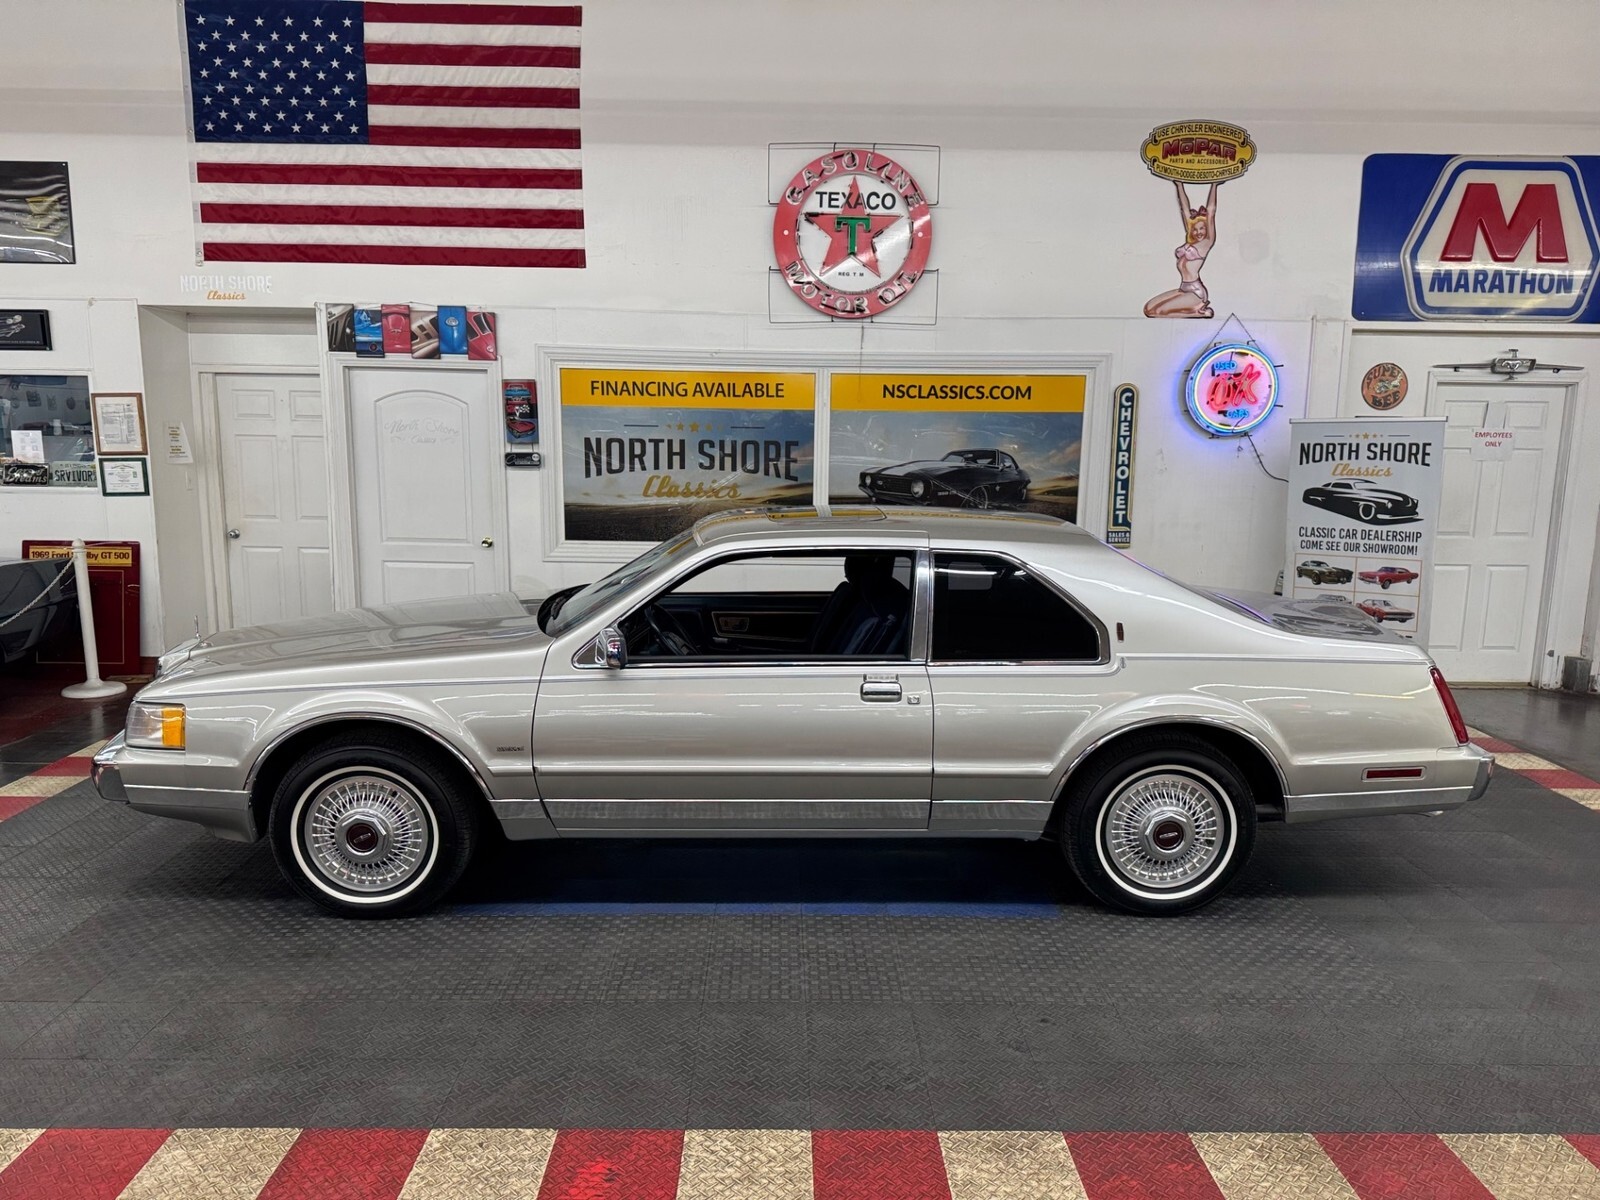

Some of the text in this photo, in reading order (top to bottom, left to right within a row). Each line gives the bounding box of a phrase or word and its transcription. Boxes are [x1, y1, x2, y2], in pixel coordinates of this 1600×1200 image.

[1157, 124, 1243, 139] USE CHRYSLER ENGINEERED
[1162, 137, 1237, 161] MOPAR
[785, 151, 925, 211] GASOLINE
[815, 191, 897, 210] TEXACO
[1439, 183, 1569, 263] M
[835, 215, 871, 256] T
[180, 274, 272, 294] NORTH SHORE
[785, 260, 920, 316] MOTOR OIL
[1428, 269, 1574, 294] MARATHON
[207, 290, 247, 301] Classics
[1214, 361, 1236, 370] USED
[1367, 364, 1402, 390] SUPER
[591, 381, 785, 398] FINANCING AVAILABLE
[882, 384, 1032, 400] NSCLASSICS.COM
[1371, 391, 1401, 408] BEE
[1474, 431, 1513, 439] EMPLOYEES
[584, 437, 799, 482] NORTH SHORE
[1115, 392, 1133, 523] CHEVROLET
[1299, 442, 1432, 467] NORTH SHORE
[55, 470, 93, 481] SRVIVOR
[1331, 463, 1393, 477] Classics
[642, 475, 742, 499] Classics
[1299, 527, 1422, 543] CLASSIC CAR DEALERSHIP
[52, 551, 70, 559] Ford
[101, 551, 112, 559] GT
[1300, 540, 1418, 556] COME SEE OUR SHOWROOM!
